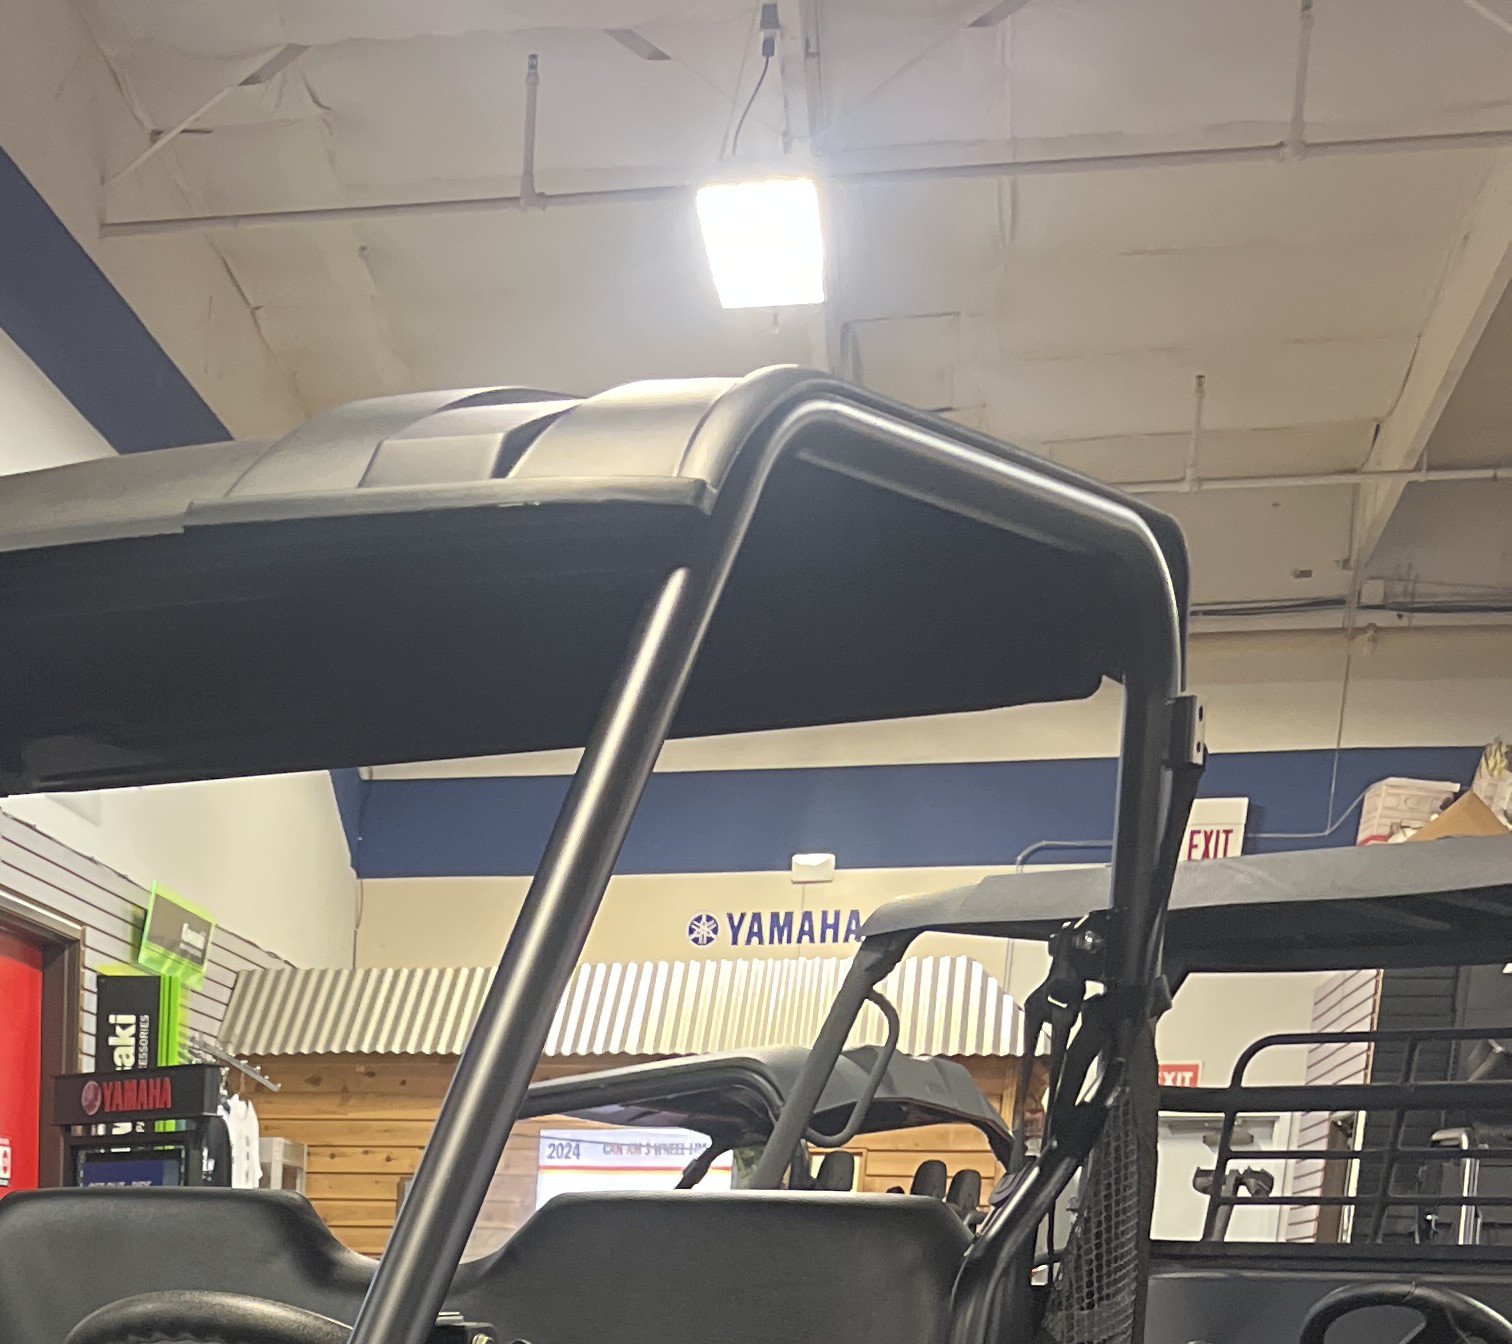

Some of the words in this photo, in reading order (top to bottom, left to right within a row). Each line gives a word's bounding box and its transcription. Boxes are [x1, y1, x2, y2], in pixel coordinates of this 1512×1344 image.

[1187, 829, 1233, 861] EXIT
[726, 909, 864, 946] YAMAHA
[138, 1014, 150, 1069] ESSORIES
[102, 1076, 172, 1113] YAMAHA
[546, 1142, 581, 1160] 2024
